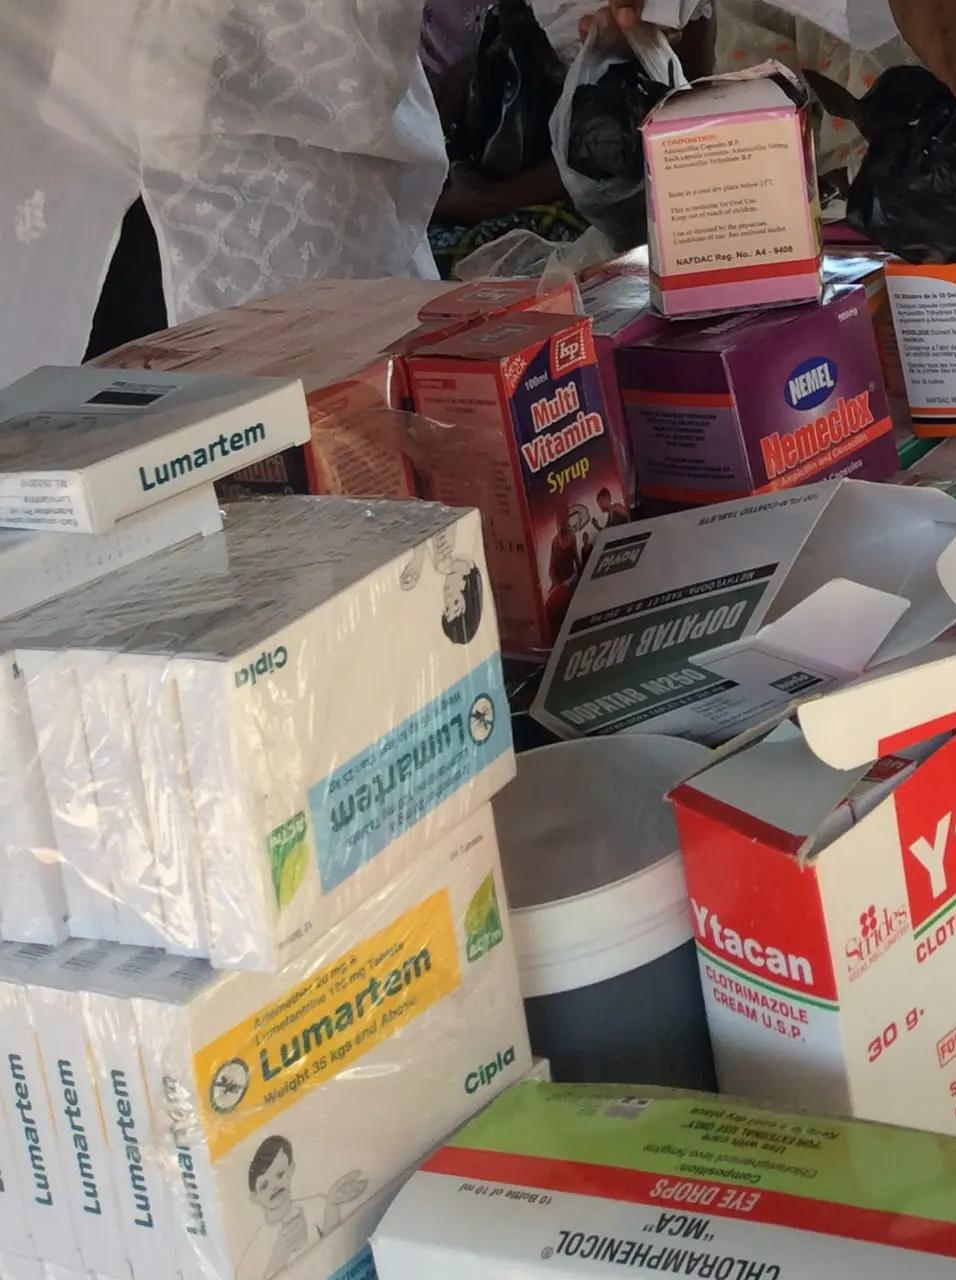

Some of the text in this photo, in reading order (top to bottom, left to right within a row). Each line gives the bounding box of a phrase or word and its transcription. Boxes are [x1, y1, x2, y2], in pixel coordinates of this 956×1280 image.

[676, 254, 713, 267] NAFDAC
[715, 252, 732, 262] Reg.
[524, 372, 549, 392] 100ml
[531, 381, 580, 433] Multi
[788, 361, 835, 405] NEMEL
[139, 421, 266, 492] Lumartem
[521, 411, 605, 473] Vitamin
[760, 390, 876, 481] Nemeclox
[546, 455, 590, 494] Syrup
[234, 644, 289, 689] Cipla
[562, 599, 748, 682] DOPATAB M250
[560, 679, 647, 727] DOPATAB
[647, 665, 707, 697] M250
[330, 712, 465, 833] Lumartem
[689, 897, 815, 987] Ytacan
[845, 903, 909, 967] Strides
[259, 948, 432, 1082] Lumartem
[705, 963, 810, 1025] CLOTRIMAZOLE
[712, 986, 806, 1044] CREAM U.S.P.
[312, 1055, 328, 1074] 35
[330, 1037, 352, 1064] kgs
[463, 1045, 516, 1094] Cipla
[867, 1023, 898, 1064] 30
[8, 1053, 53, 1207] Lumartem
[57, 1059, 102, 1215] Lumartem
[110, 1069, 154, 1229] Lumartem
[457, 1181, 552, 1206] 10 Bottle of 10 ml
[650, 1178, 761, 1212] EYE DROPS
